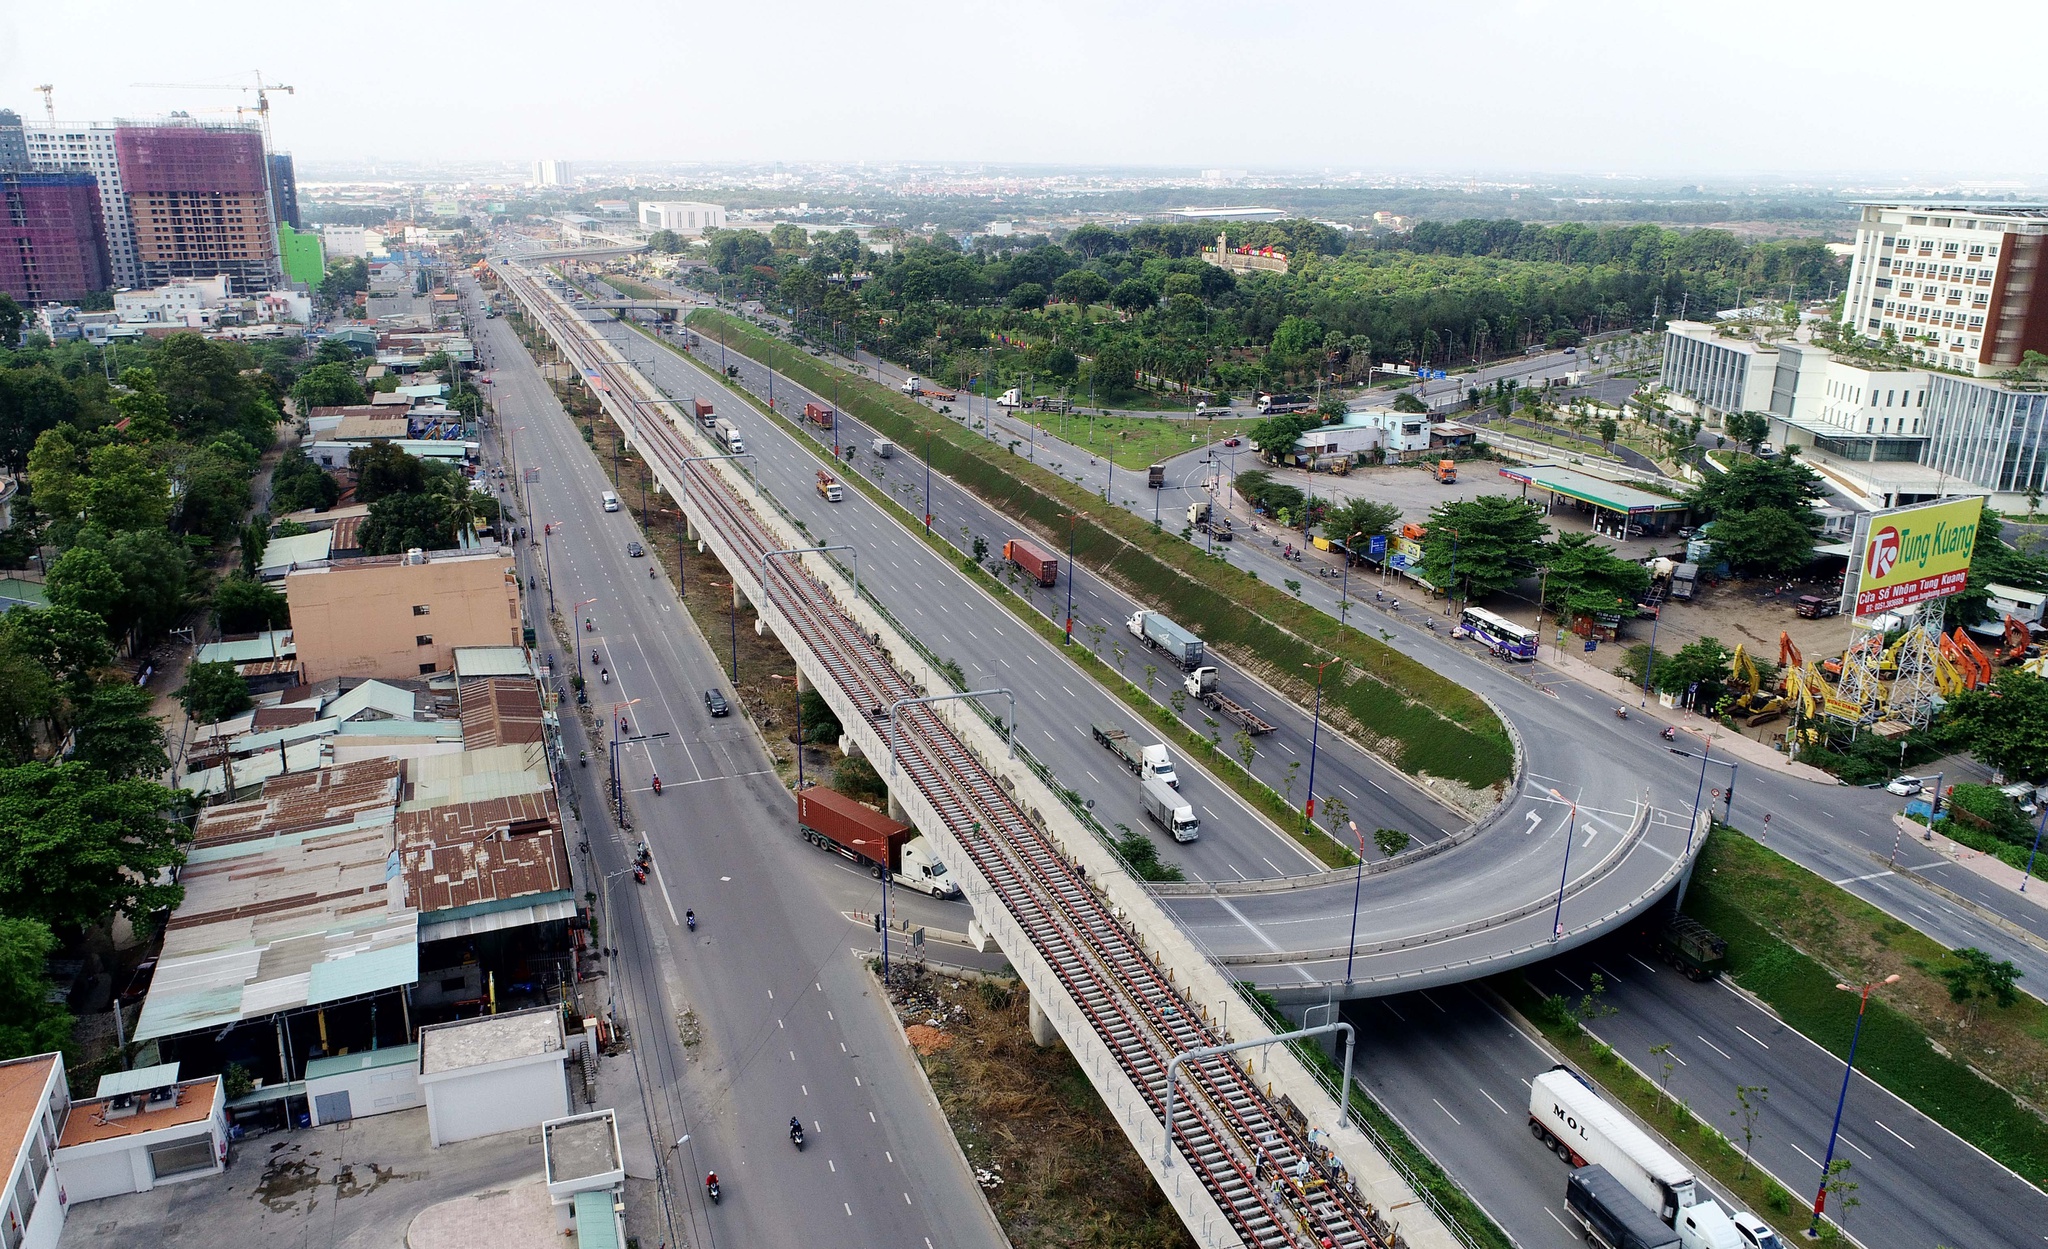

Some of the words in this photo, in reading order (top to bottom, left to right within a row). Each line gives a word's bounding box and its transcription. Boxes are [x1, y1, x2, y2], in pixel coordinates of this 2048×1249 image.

[1899, 529, 1931, 568] Tung
[1932, 521, 1975, 558] Kuang
[1859, 590, 1875, 604] Cửa
[1892, 582, 1917, 597] Nhôm
[1920, 577, 1939, 590] Tung
[1941, 572, 1966, 585] Kuang
[1553, 1102, 1588, 1141] MOL
